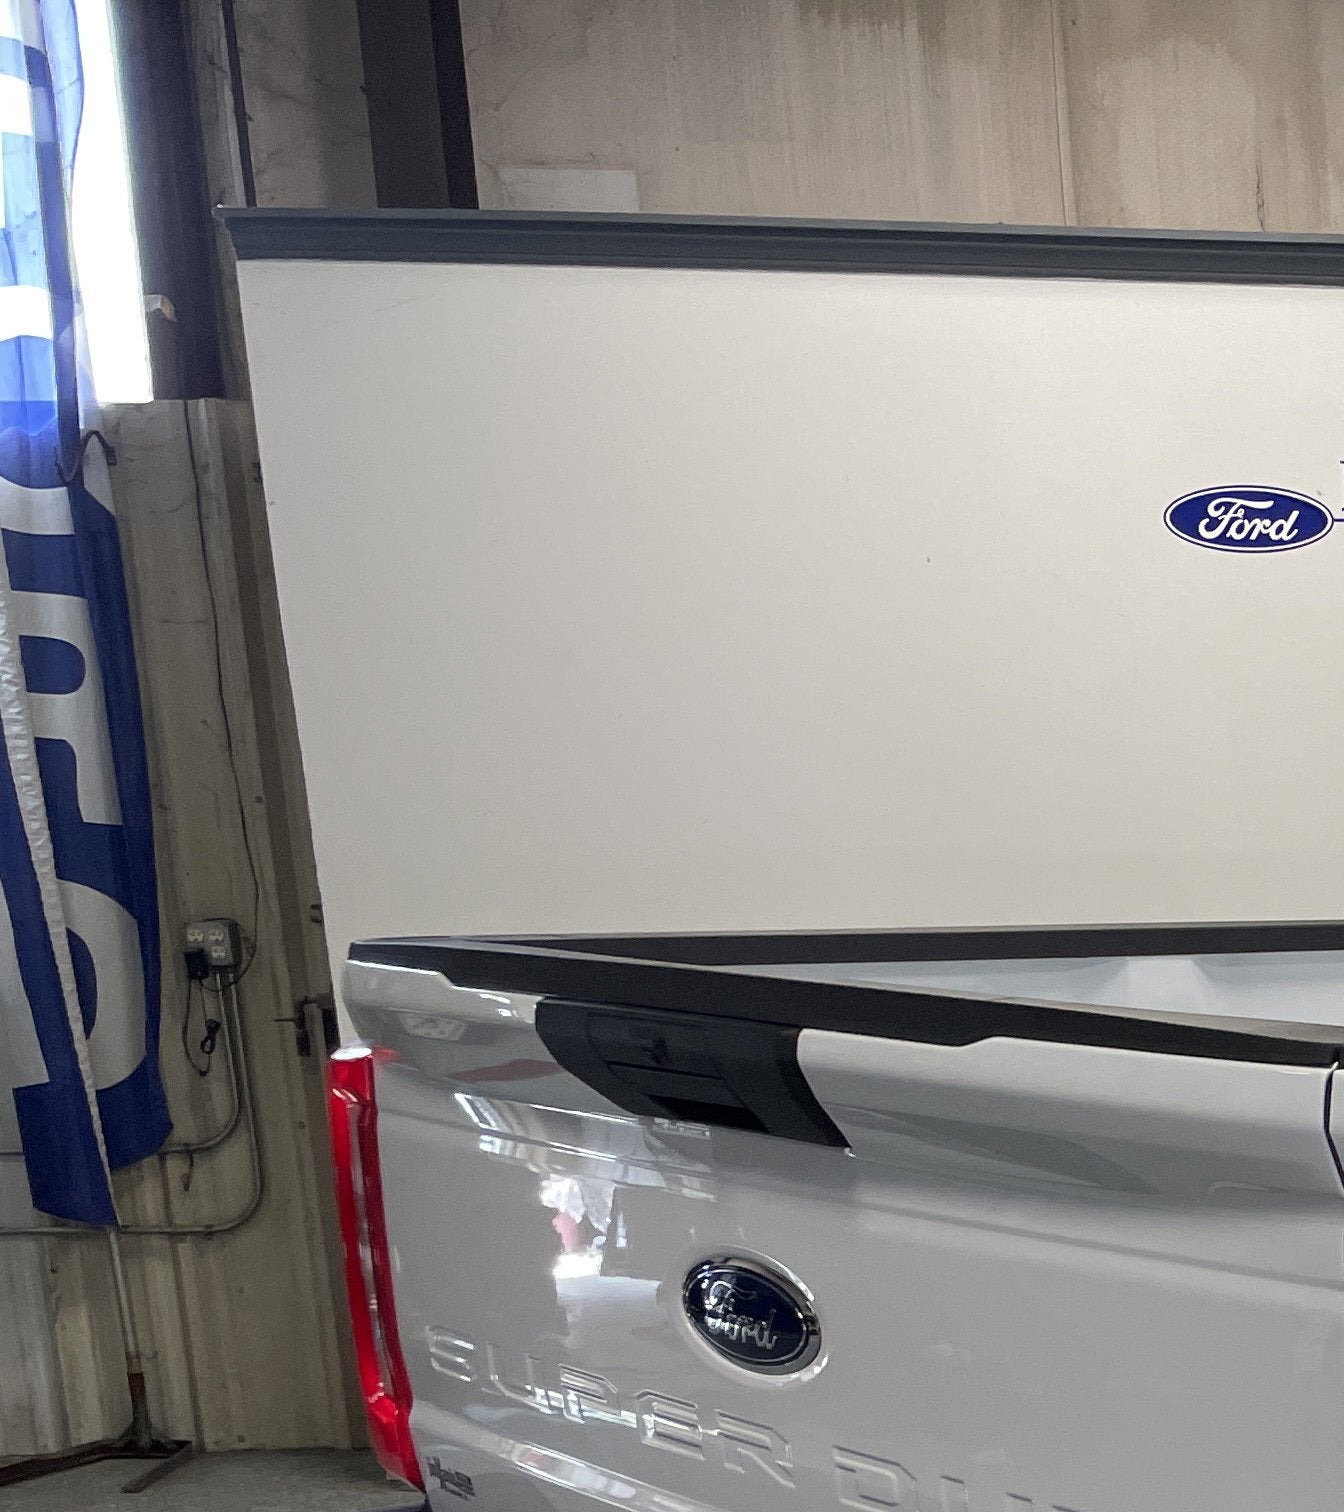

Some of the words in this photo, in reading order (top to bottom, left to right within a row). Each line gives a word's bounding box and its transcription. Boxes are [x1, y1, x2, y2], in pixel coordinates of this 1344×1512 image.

[1197, 496, 1299, 544] Ford
[704, 1280, 778, 1350] Ford
[425, 1325, 797, 1489] SUPER
